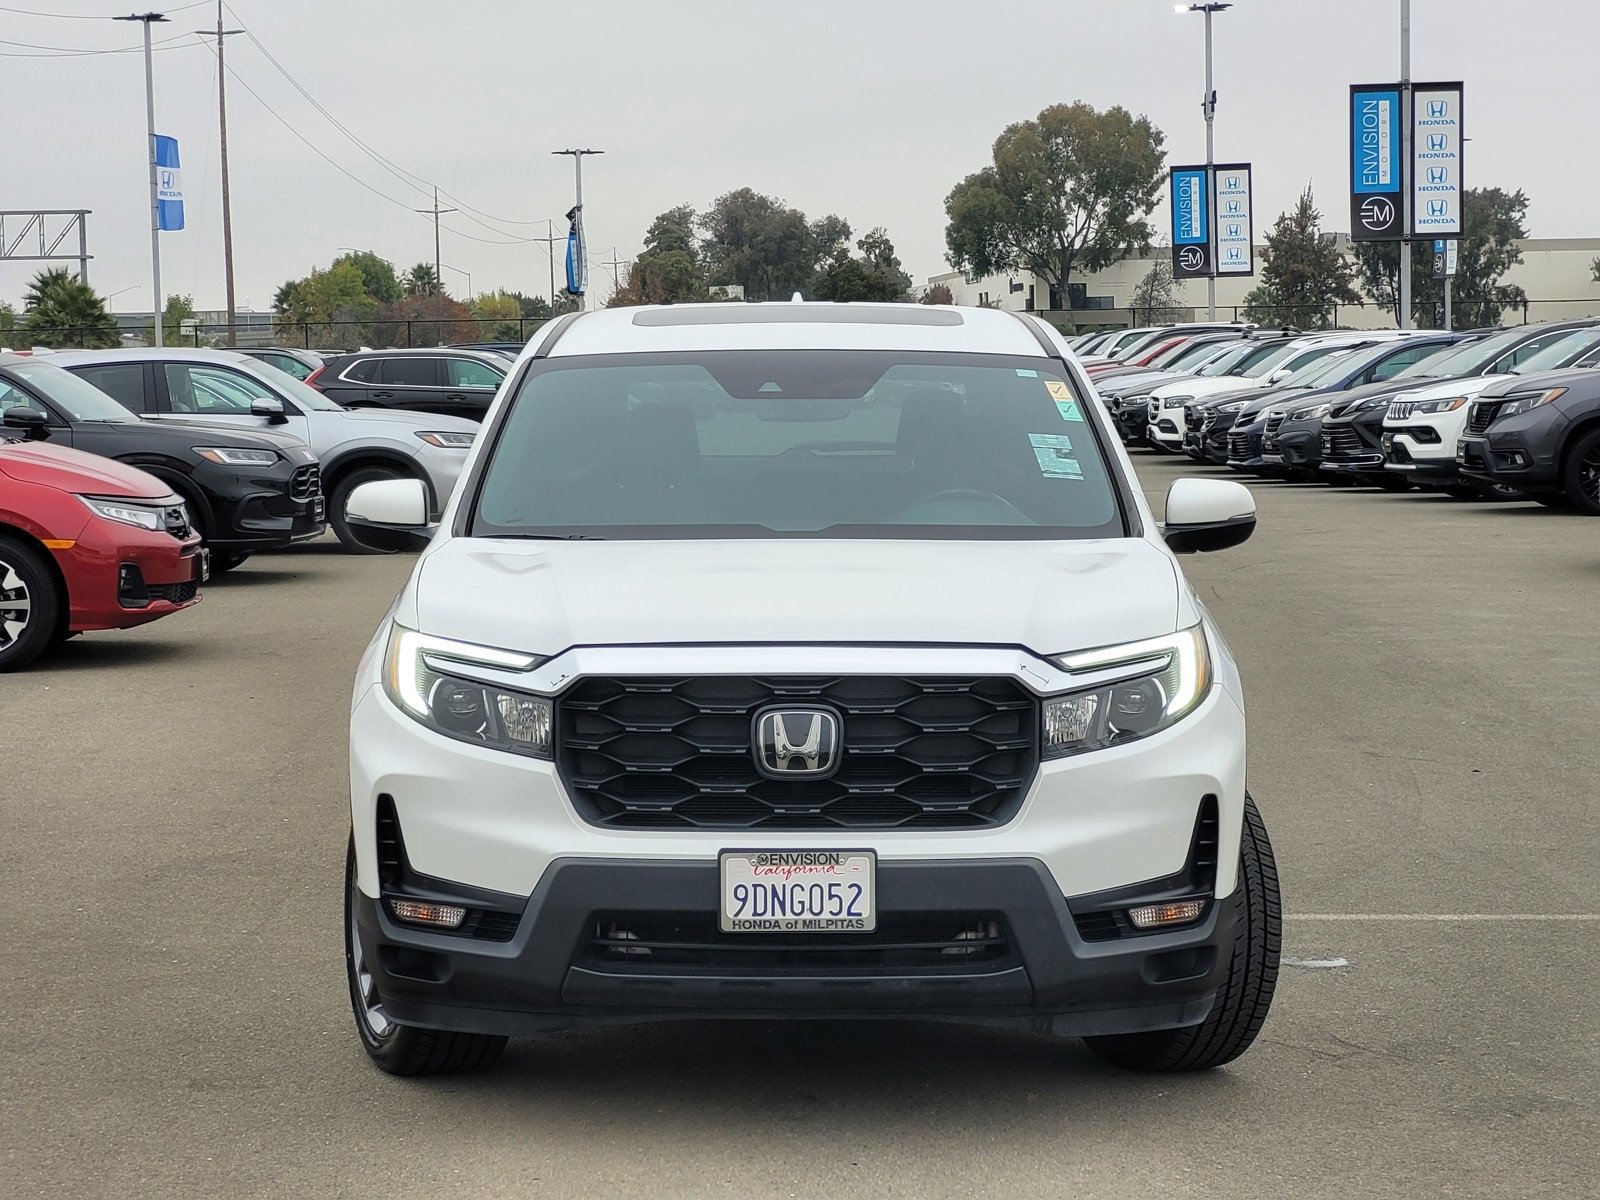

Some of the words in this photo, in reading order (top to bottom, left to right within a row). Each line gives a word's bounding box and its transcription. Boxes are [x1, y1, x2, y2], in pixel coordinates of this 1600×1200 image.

[1362, 100, 1378, 185] ENVISION
[1180, 177, 1192, 238] ENVISION
[770, 853, 840, 866] ENVISION
[754, 865, 845, 881] California
[733, 883, 863, 917] 9DNG052
[732, 919, 781, 930] HONDA
[785, 919, 798, 930] of
[803, 919, 865, 930] MILPITAS
